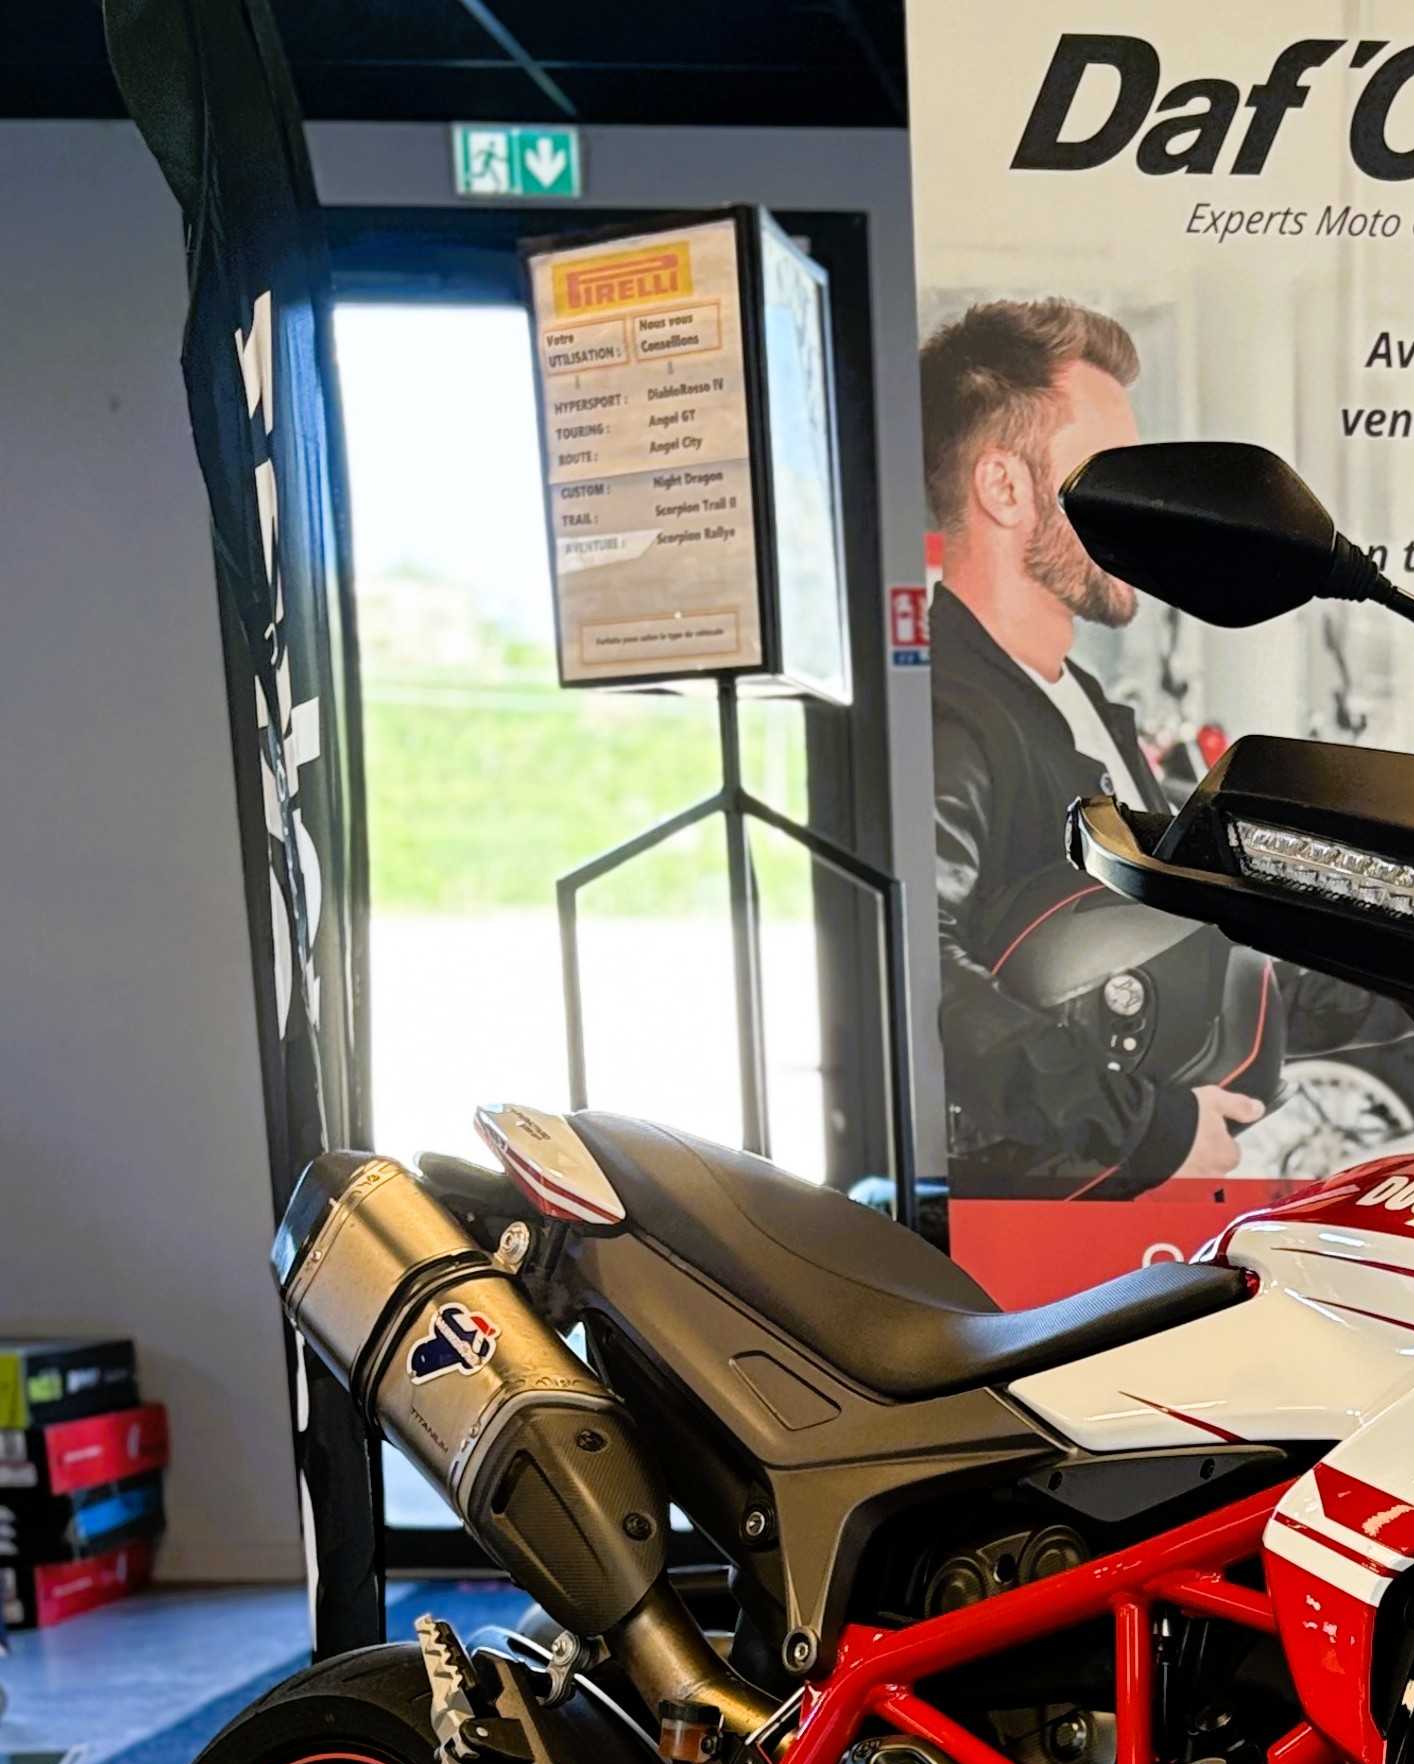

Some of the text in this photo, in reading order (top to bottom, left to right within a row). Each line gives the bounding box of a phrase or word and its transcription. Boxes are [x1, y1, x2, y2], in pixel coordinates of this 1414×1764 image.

[1185, 203, 1307, 242] Experts
[1316, 206, 1401, 238] Moto
[566, 254, 679, 308] PIRELLI
[639, 314, 693, 331] Nous vous
[547, 334, 575, 347] Votre
[640, 334, 699, 353] Conseillons
[649, 409, 696, 429] Angel GT
[650, 436, 702, 455] Angel City
[653, 471, 723, 491] Night Dragon
[655, 502, 700, 518] Scorpion
[702, 497, 726, 512] Trail
[656, 532, 701, 546] Scorpion
